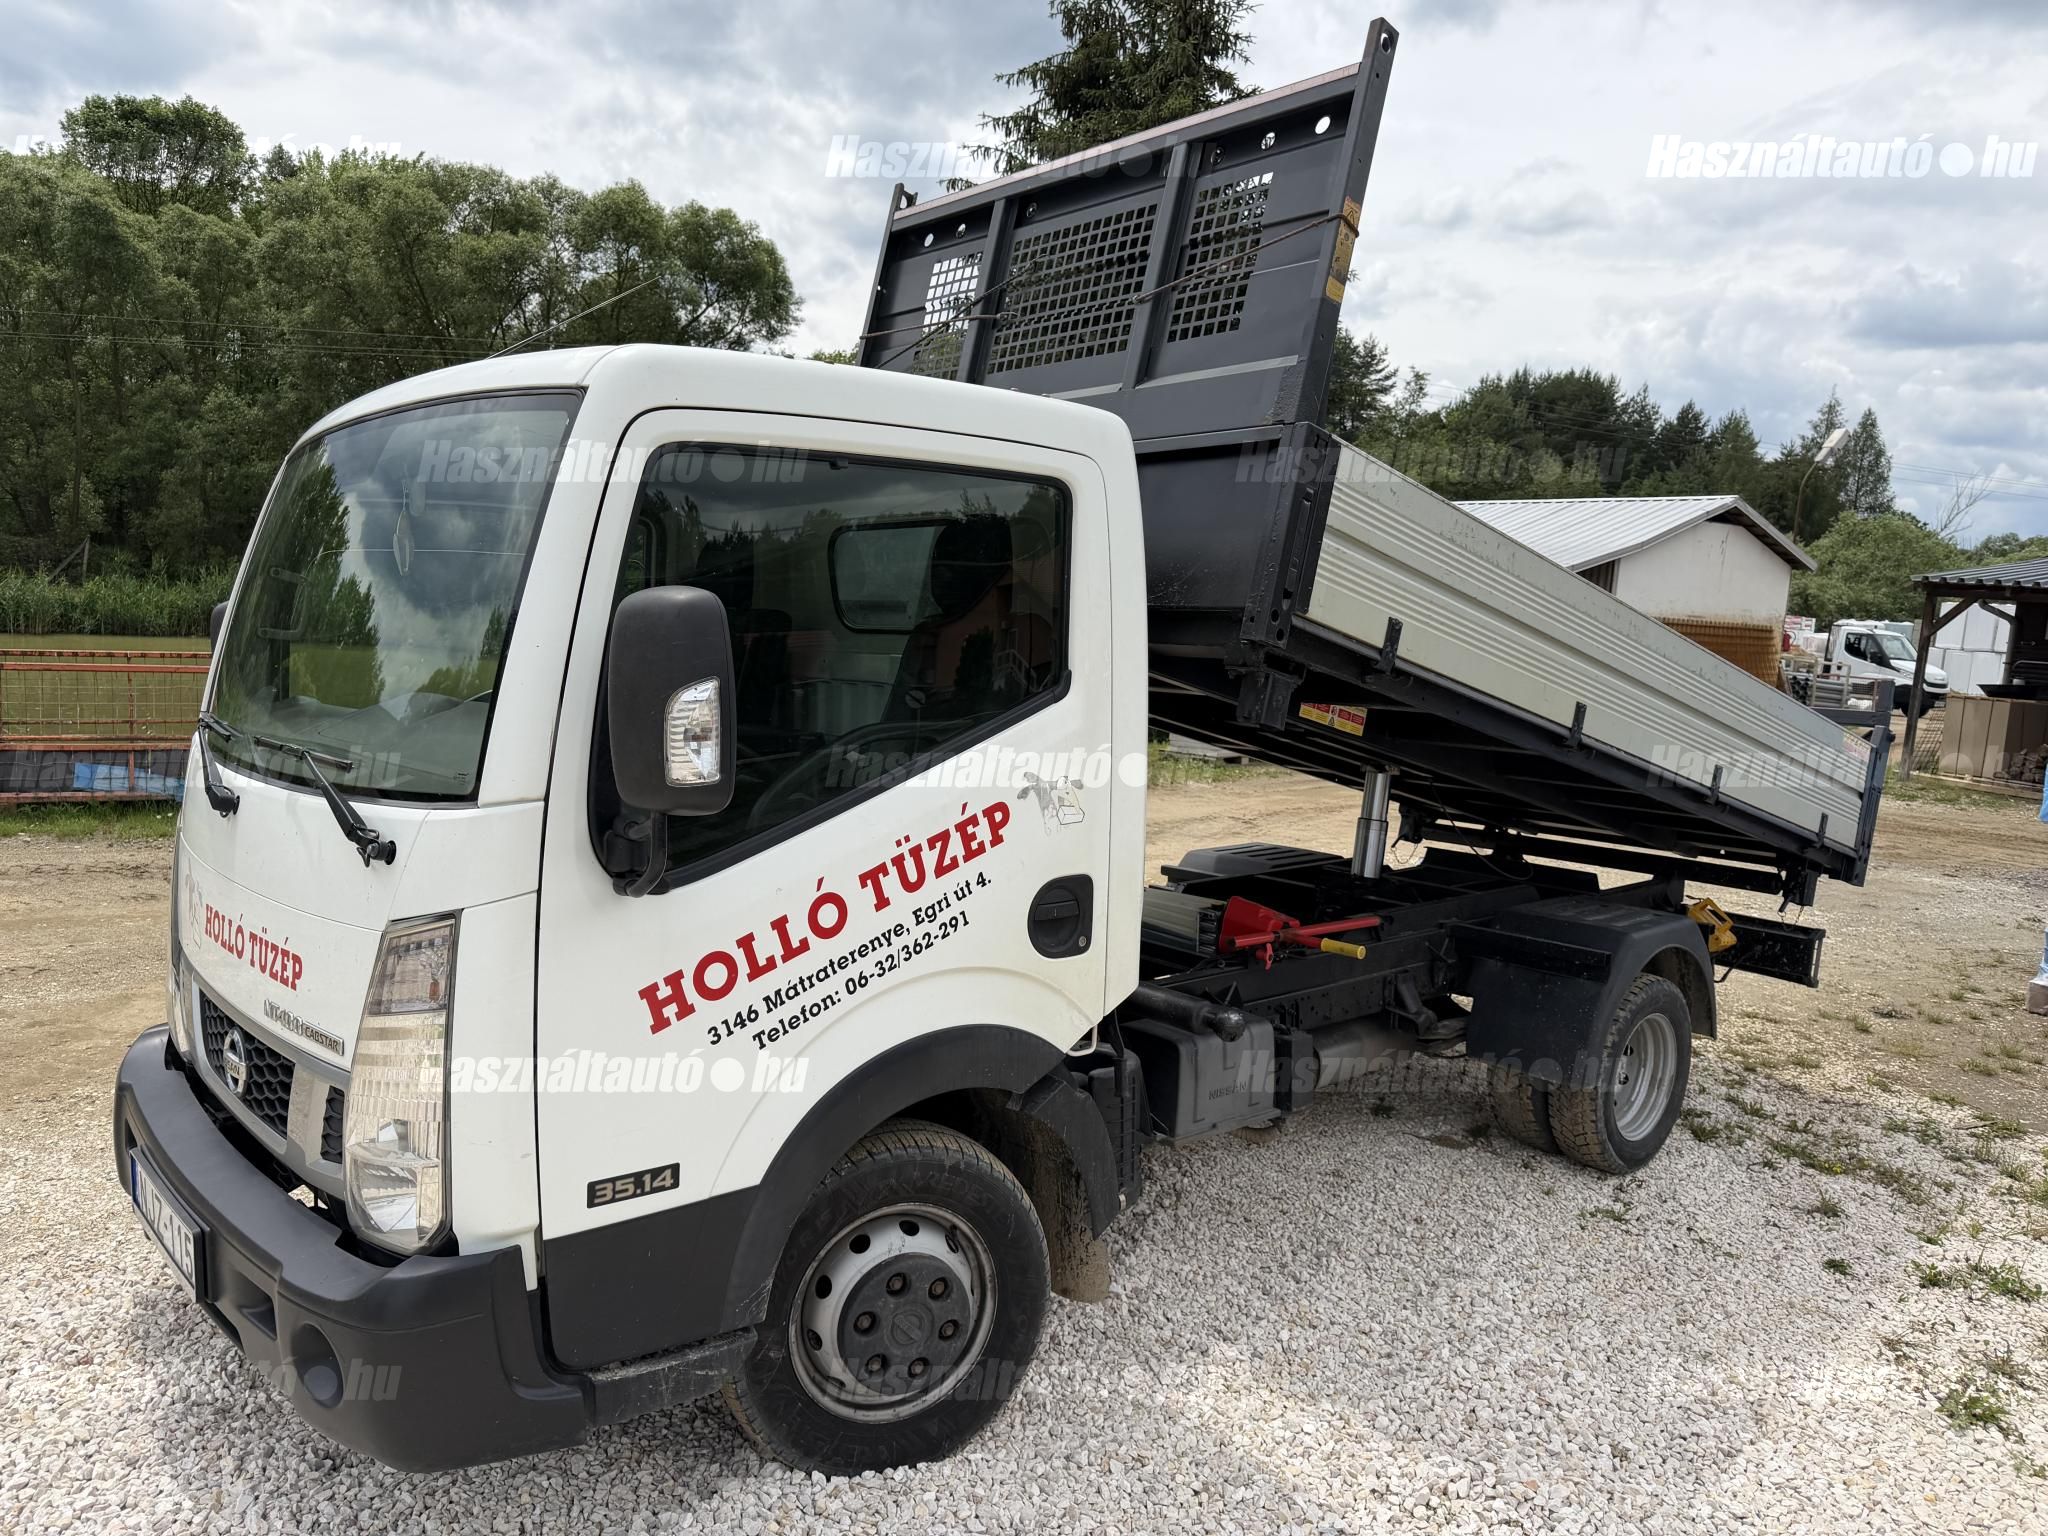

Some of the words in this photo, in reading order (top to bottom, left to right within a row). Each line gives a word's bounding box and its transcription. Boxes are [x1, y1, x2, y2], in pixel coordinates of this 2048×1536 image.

[204, 903, 245, 960] HOLLÓ
[249, 926, 303, 991] TÜZÉP
[638, 876, 848, 1035] HOLLÓ
[858, 802, 1011, 913] TÜZÉP
[707, 1004, 759, 1045] 3146
[762, 922, 910, 1014] Mátraterenye,
[912, 892, 951, 926] Egri
[953, 880, 973, 902] út
[976, 871, 992, 888] 4.
[752, 990, 842, 1050] Telefon:
[845, 910, 970, 995] 06-32/362-291
[304, 1026, 339, 1051] CABSTAR
[593, 1168, 674, 1204] 35.14
